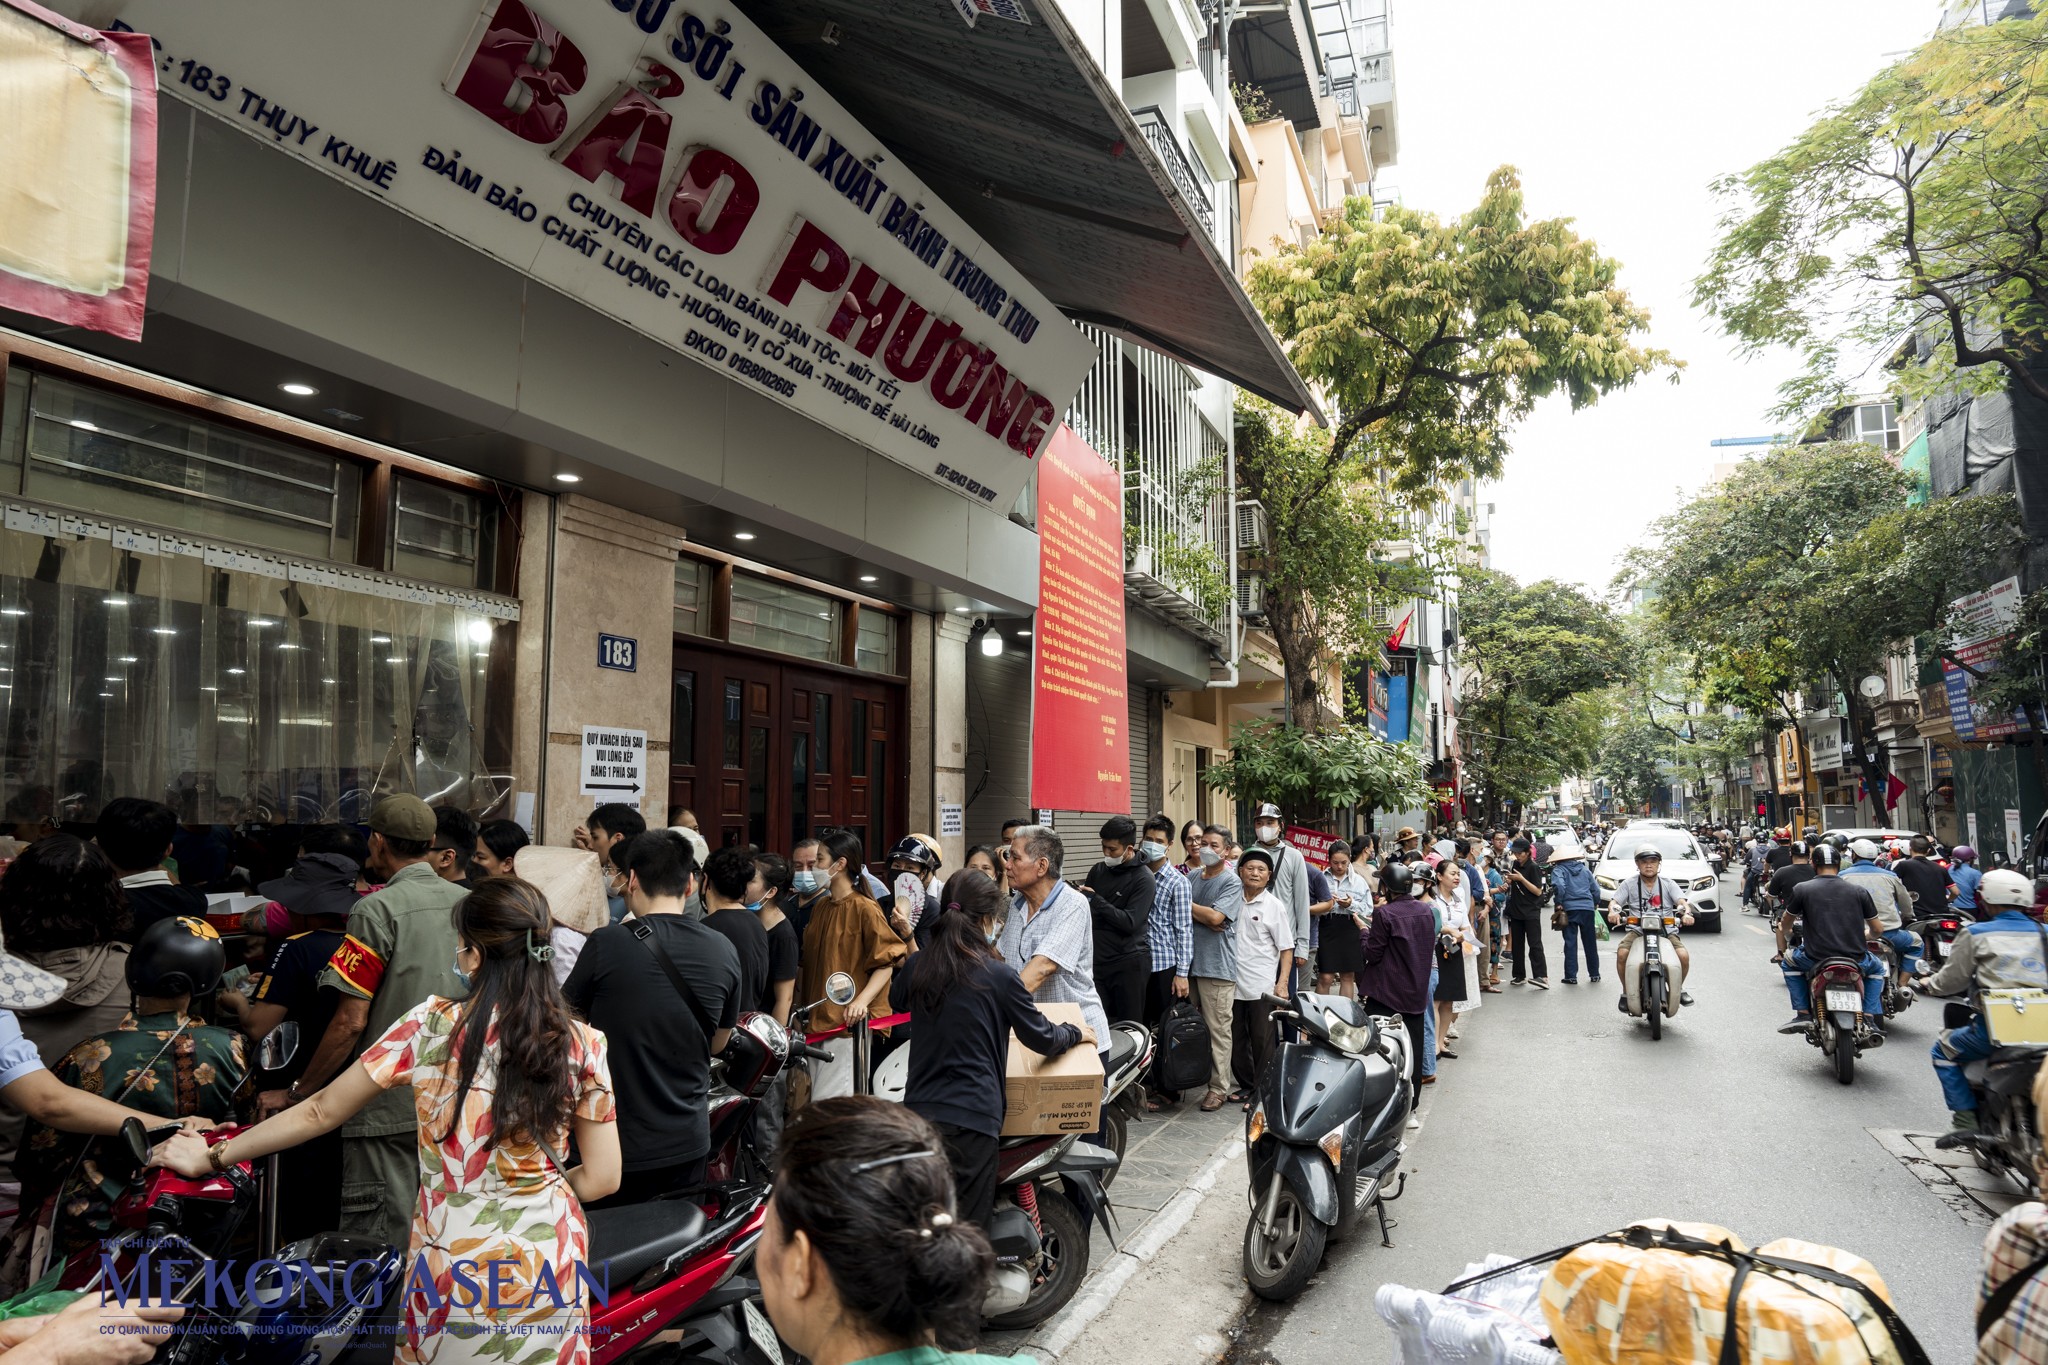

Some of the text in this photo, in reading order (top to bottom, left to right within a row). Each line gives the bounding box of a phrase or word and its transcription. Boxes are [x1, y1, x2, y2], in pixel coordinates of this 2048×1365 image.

[180, 58, 397, 190] 183 THỤY KHUÊ
[667, 13, 734, 81] SỞ
[747, 80, 824, 163] SẢN
[810, 135, 888, 215] XUẤT
[878, 193, 949, 269] BÁNH
[940, 246, 1008, 319] TRUNG
[1000, 297, 1040, 344] THU
[443, 0, 1056, 459] BẢO PHƯƠNG
[421, 145, 484, 194] ĐẢM
[484, 182, 538, 223] BẢO
[542, 215, 602, 258] CHẤT
[602, 249, 670, 299] LƯỢNG
[680, 290, 741, 338] HƯƠNG
[742, 327, 760, 352] VỊ
[761, 338, 791, 361] CỔ
[784, 352, 814, 380] XƯA
[821, 372, 872, 411] THƯỢNG
[568, 192, 653, 254] CHUYÊN
[653, 243, 695, 278] CÁC
[693, 269, 735, 304] LOẠI
[734, 292, 780, 329] BÁNH
[779, 320, 811, 348] DÂN
[812, 338, 841, 366] TỘC
[876, 377, 901, 400] TẾT
[684, 328, 727, 362] ĐKKD
[75, 526, 89, 535] 12
[173, 545, 184, 553] 10
[603, 639, 632, 667] 183
[587, 731, 643, 748] QUÝ KHÁCH ĐẾN SAU
[596, 748, 633, 763] VUI LÒNG XẾP
[590, 763, 637, 779] HÀNG 1 PHÍA SAU
[1294, 833, 1309, 845] NƠI
[344, 952, 363, 973] VỆ
[1831, 1001, 1857, 1010] 3352
[1080, 1110, 1092, 1118] LỌ
